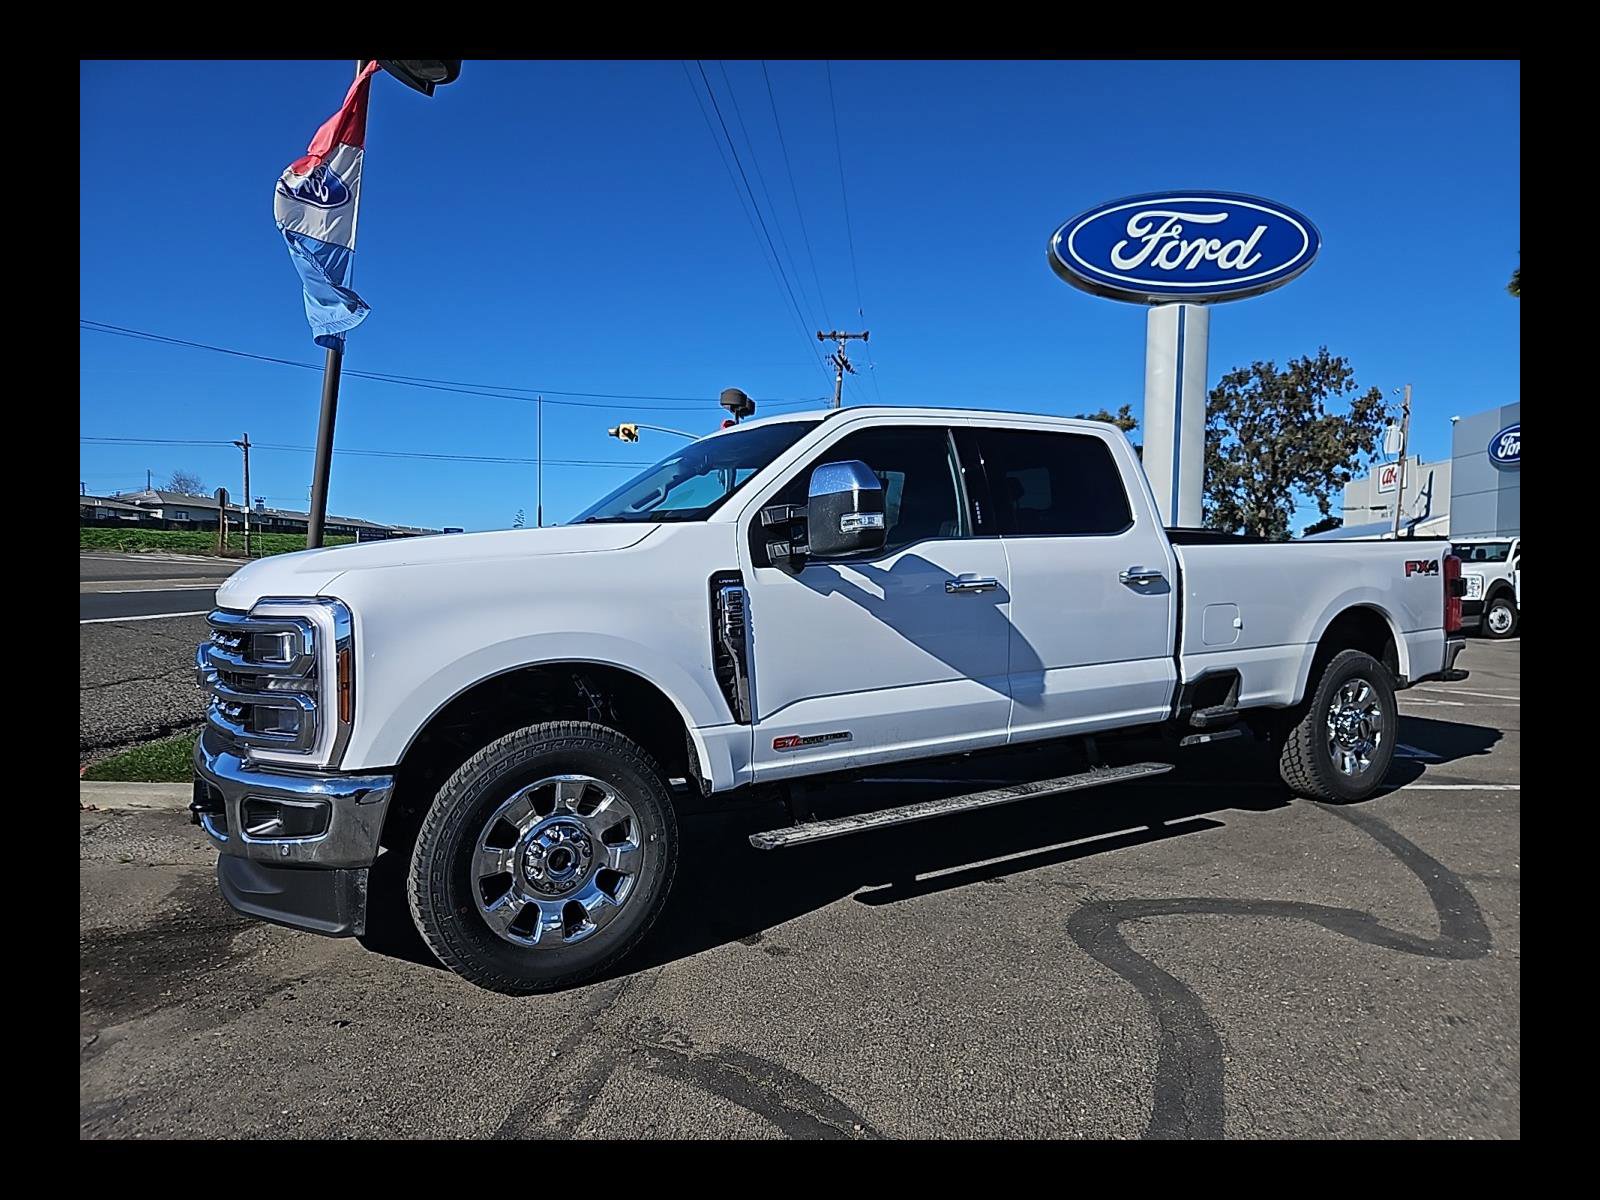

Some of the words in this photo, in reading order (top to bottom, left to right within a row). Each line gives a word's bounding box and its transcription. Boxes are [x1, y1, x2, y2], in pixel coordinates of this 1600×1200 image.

[1110, 210, 1267, 270] Ford
[1497, 432, 1520, 458] For
[1405, 560, 1439, 577] FX4
